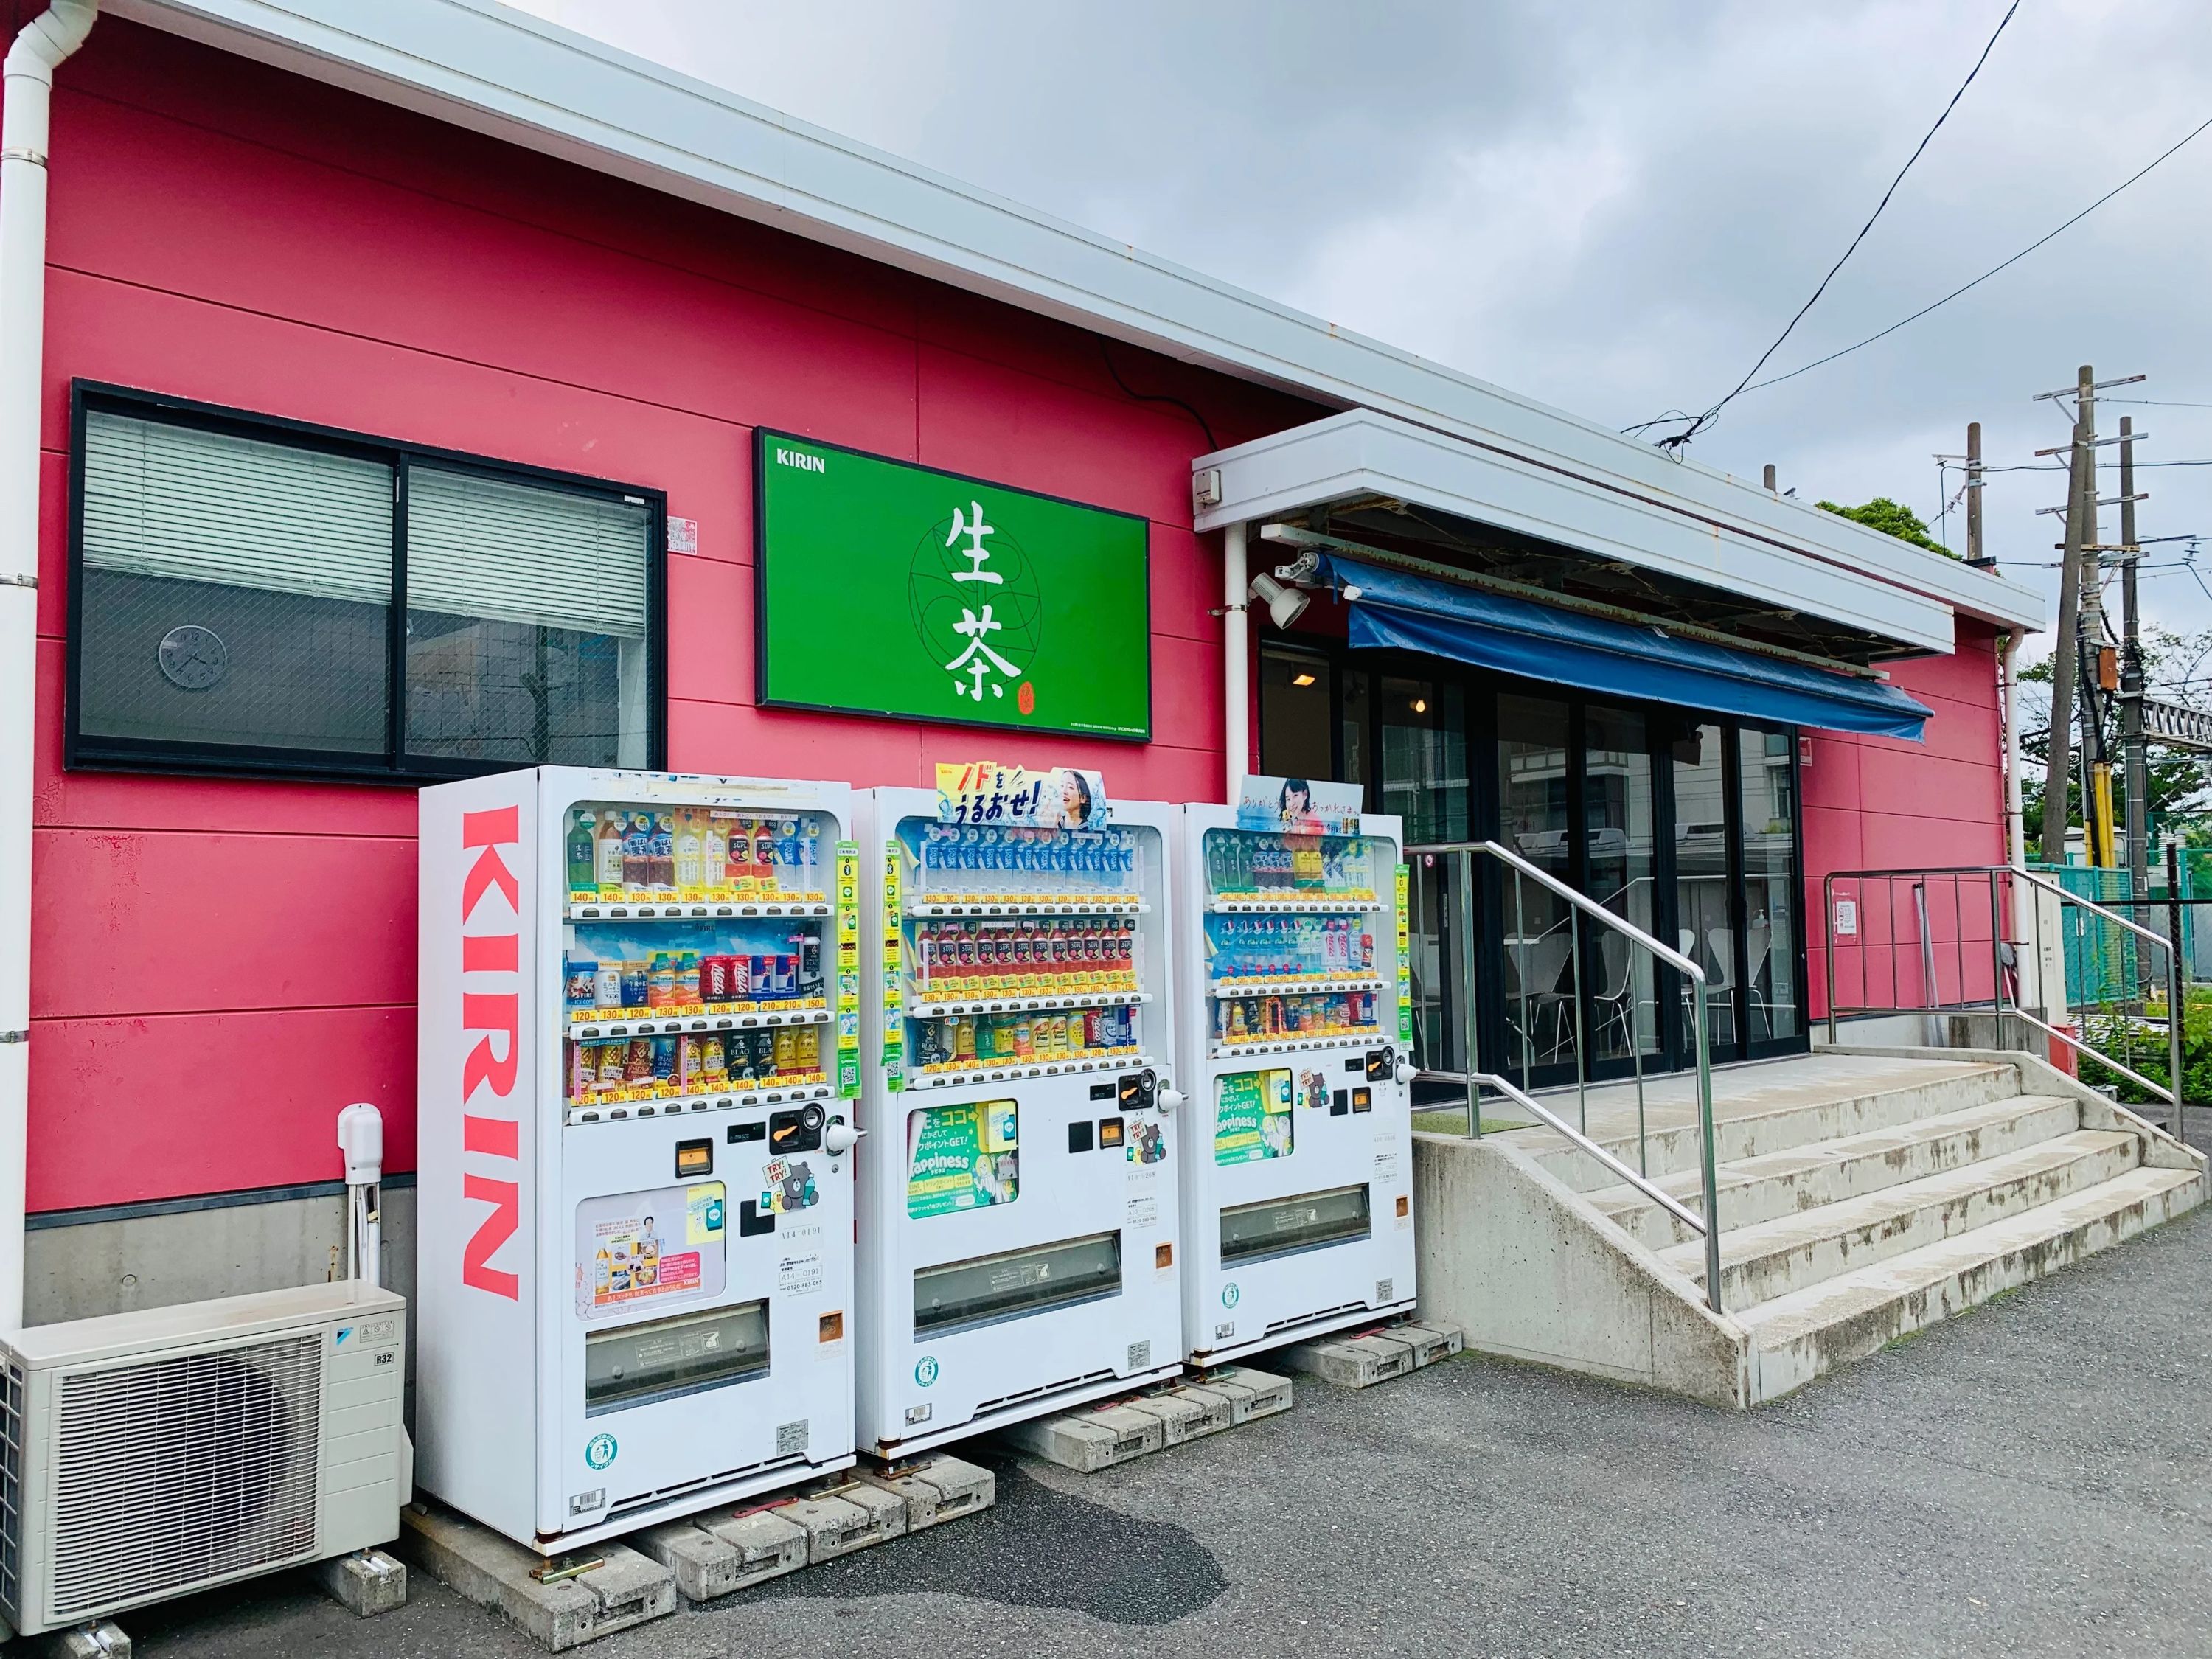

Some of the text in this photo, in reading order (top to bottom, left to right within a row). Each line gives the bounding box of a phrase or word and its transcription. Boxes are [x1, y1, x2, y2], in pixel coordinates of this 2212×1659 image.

[776, 448, 825, 473] KIRIN
[945, 500, 1021, 701] 生茶
[955, 780, 1043, 824] うるおせ!
[1243, 796, 1280, 813] ありがとう
[576, 844, 584, 860] 生茶
[713, 964, 725, 995] Mets
[736, 964, 748, 995] Mets
[462, 804, 519, 1302] KIRIN
[575, 1096, 594, 1105] 20円
[767, 1159, 785, 1175] TRY!
[770, 1168, 787, 1183] TRY!
[377, 1353, 392, 1364] R32
